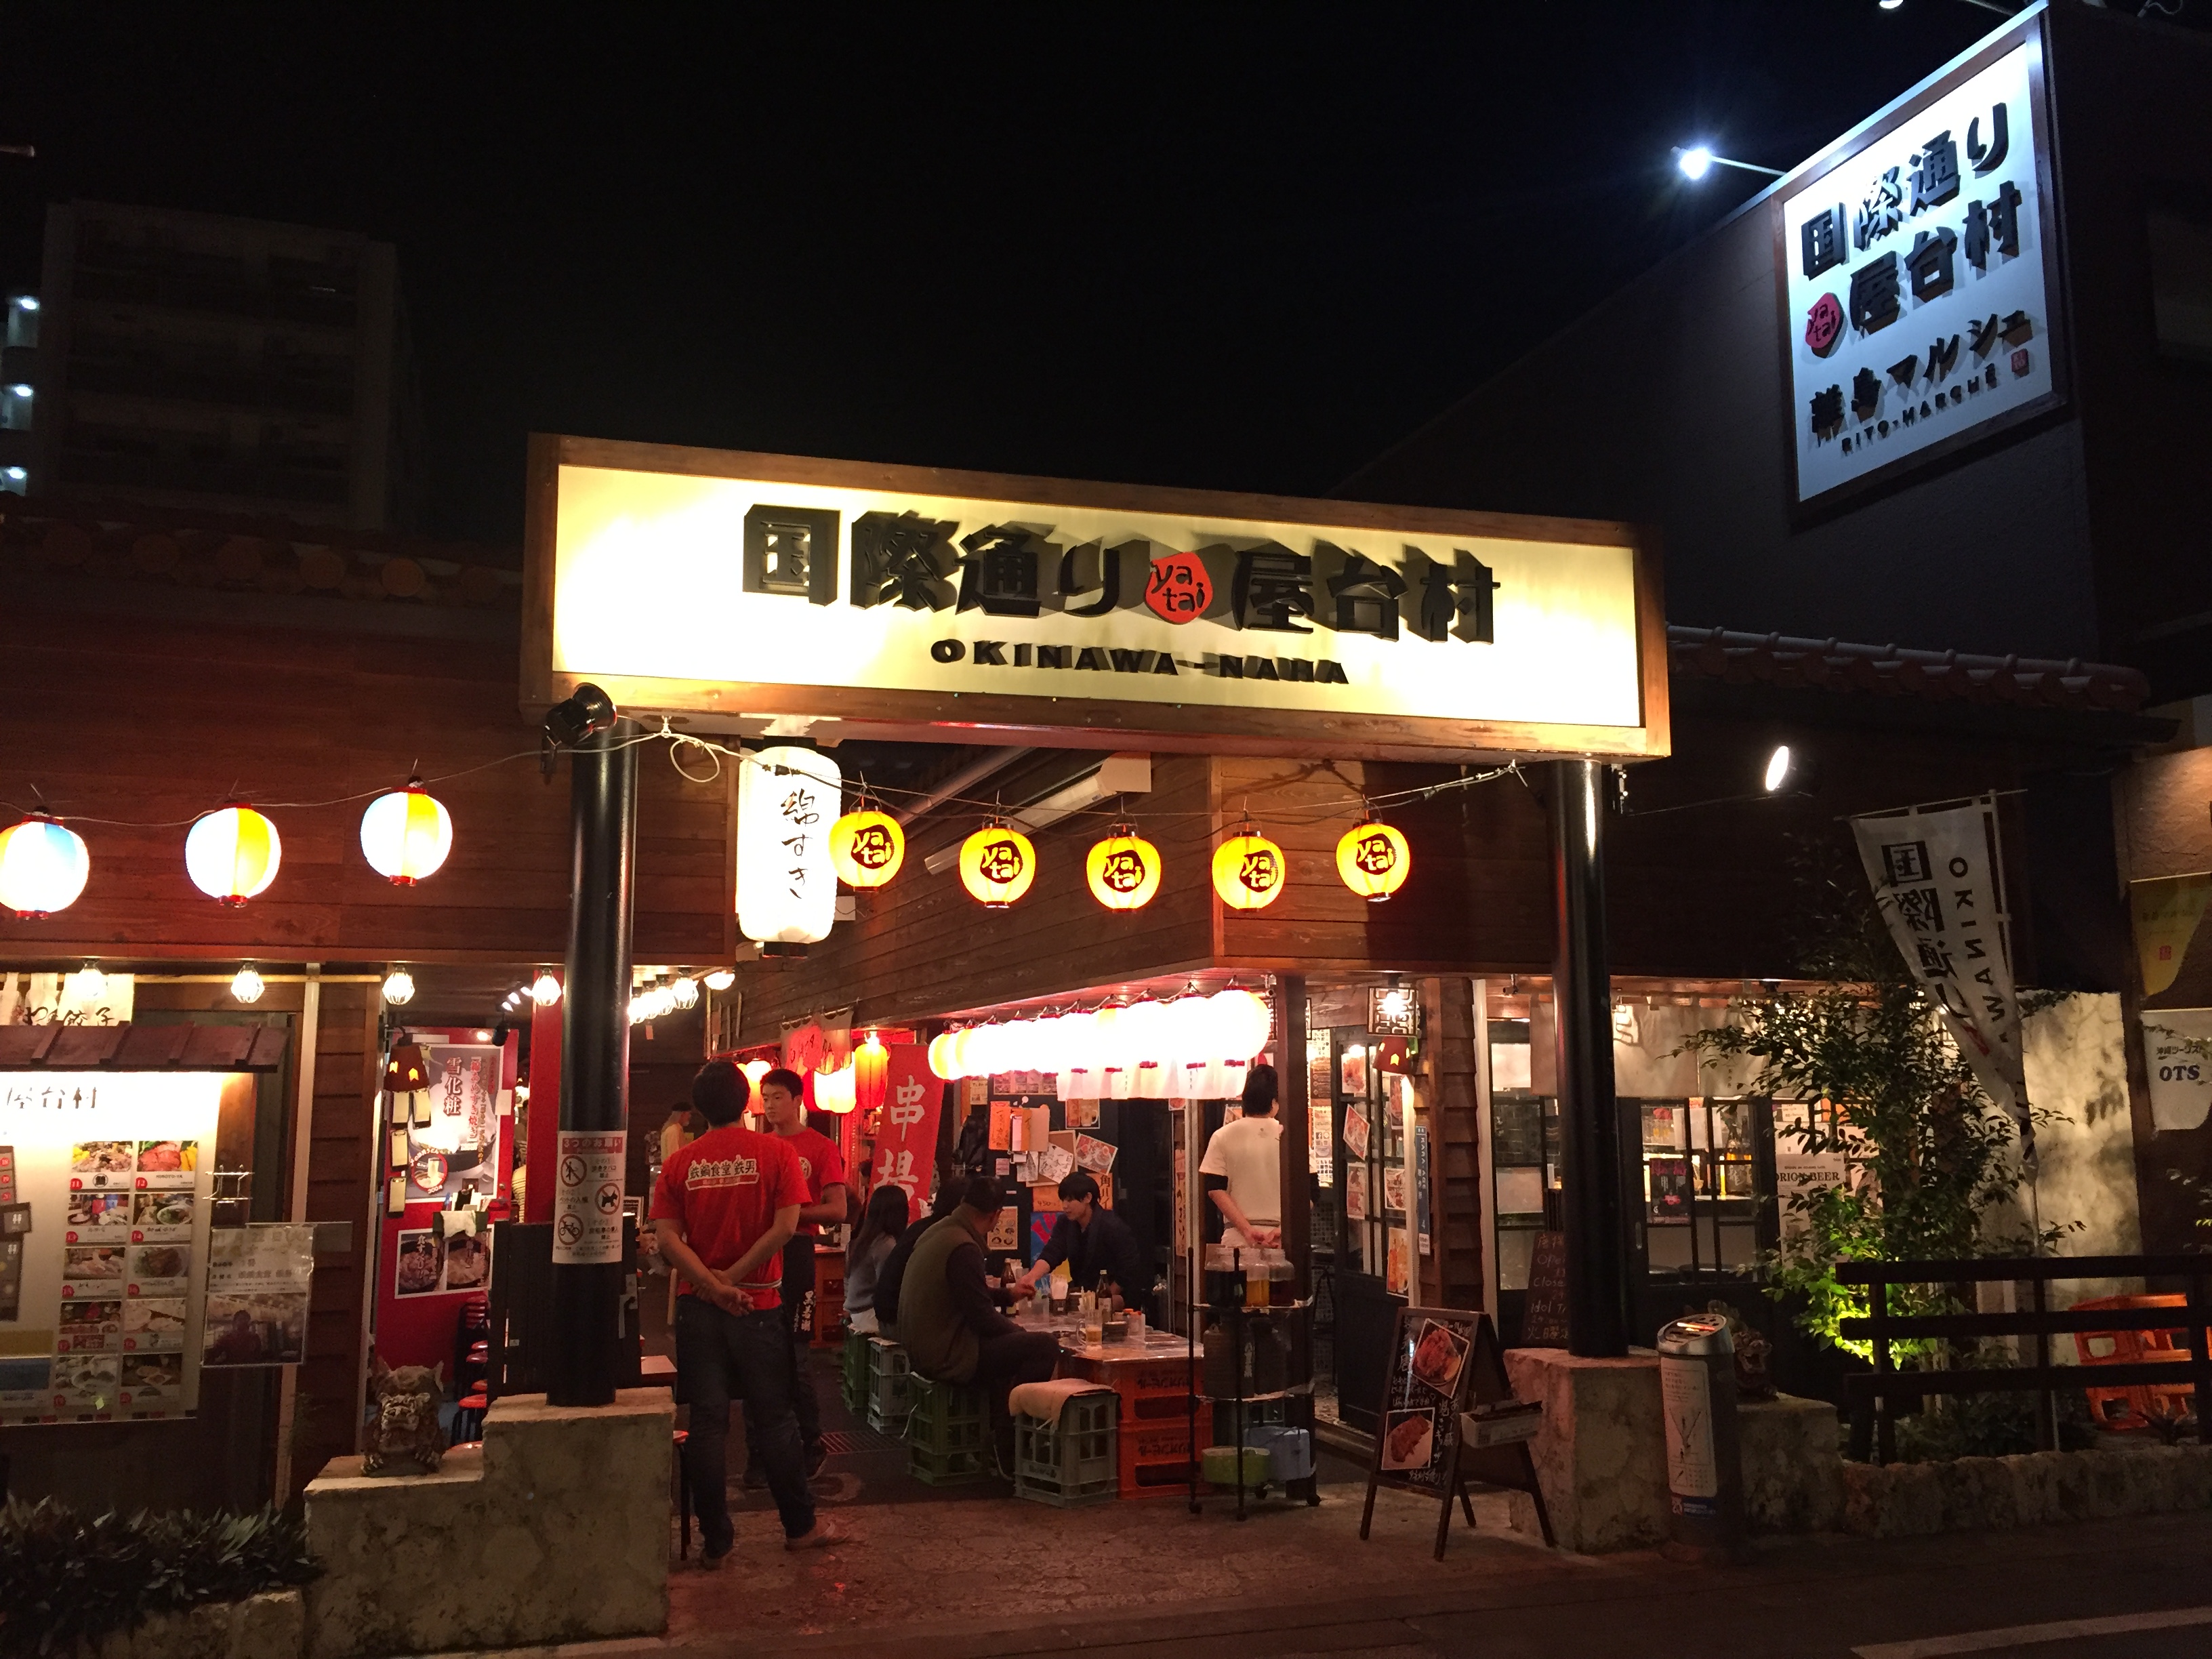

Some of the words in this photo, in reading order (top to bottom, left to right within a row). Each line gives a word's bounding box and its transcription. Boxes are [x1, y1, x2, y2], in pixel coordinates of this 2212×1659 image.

[1801, 102, 2009, 281] 国際通り
[1850, 180, 2022, 335] 屋台村
[743, 504, 1120, 618] 国際通り
[1151, 561, 1193, 594] ya
[1162, 581, 1205, 613] tai
[1232, 550, 1501, 645] 屋台村
[443, 1057, 462, 1117] 雪化粧
[2159, 1065, 2200, 1082] OTS
[1810, 1172, 1840, 1181] BEER
